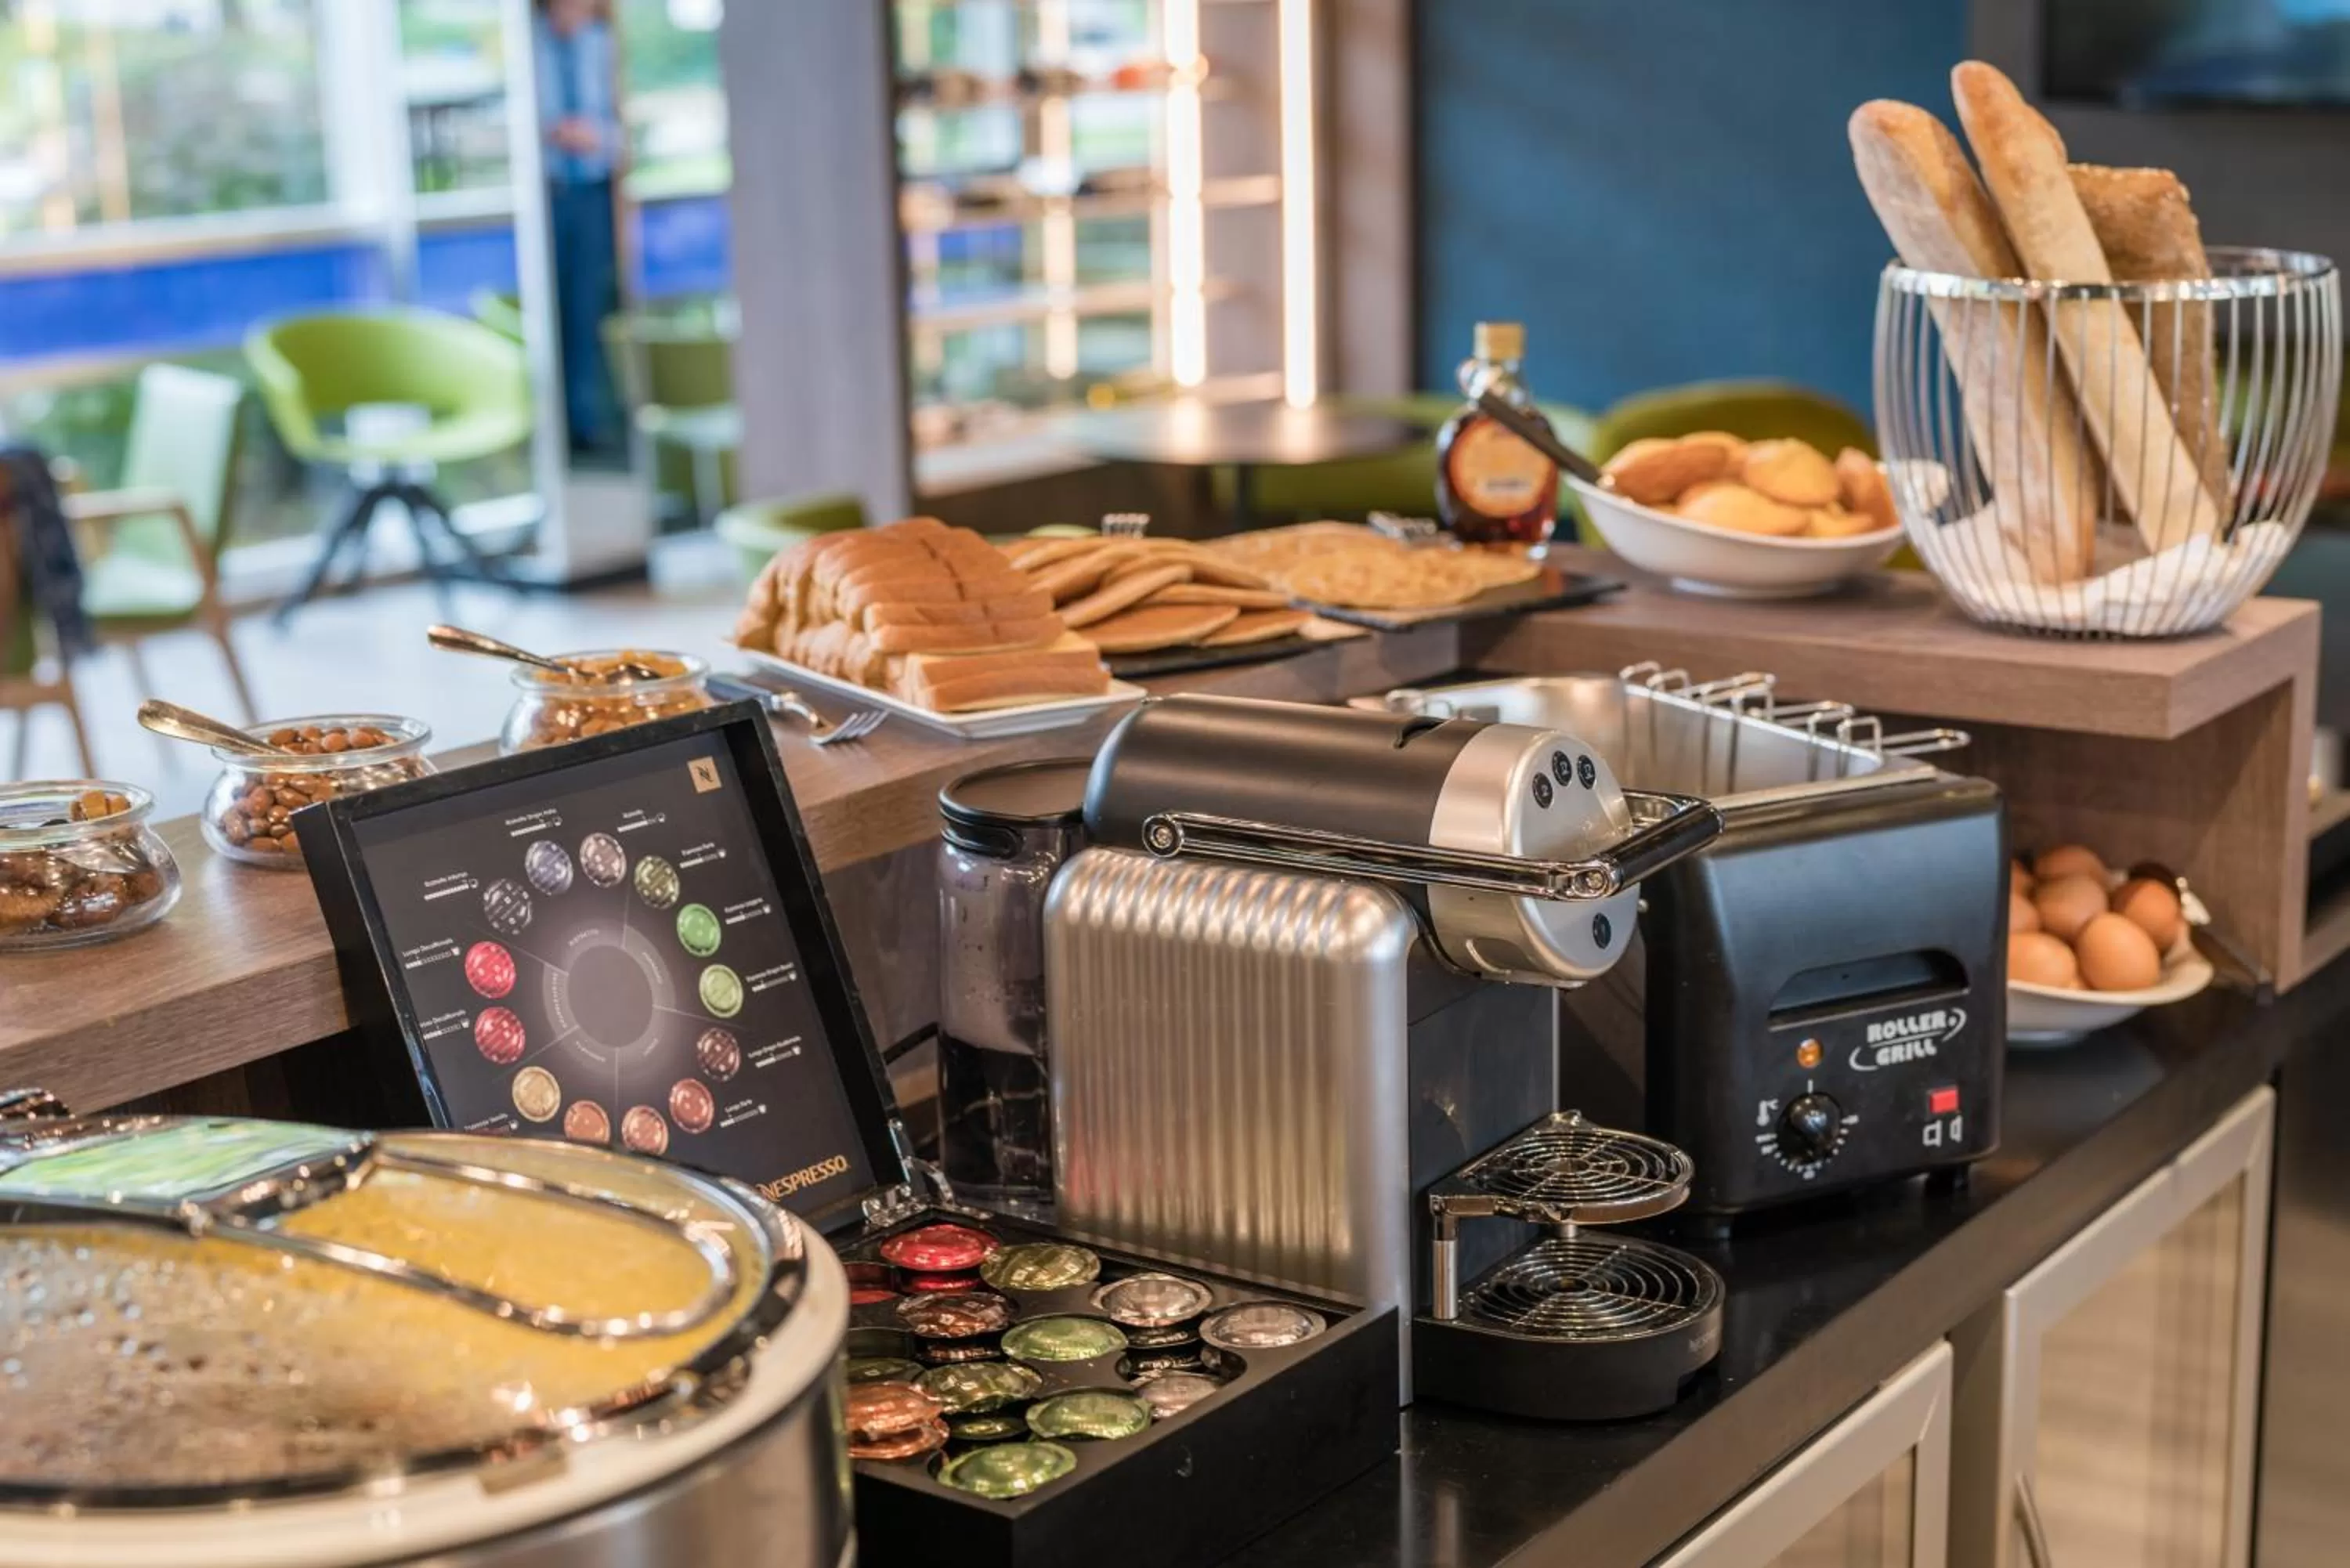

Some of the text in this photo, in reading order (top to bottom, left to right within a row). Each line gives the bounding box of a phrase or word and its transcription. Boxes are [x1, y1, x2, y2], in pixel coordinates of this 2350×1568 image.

[1867, 1010, 1947, 1042] ROLLER
[1875, 1038, 1937, 1066] GRILL
[755, 1154, 847, 1201] NESPRESSO
